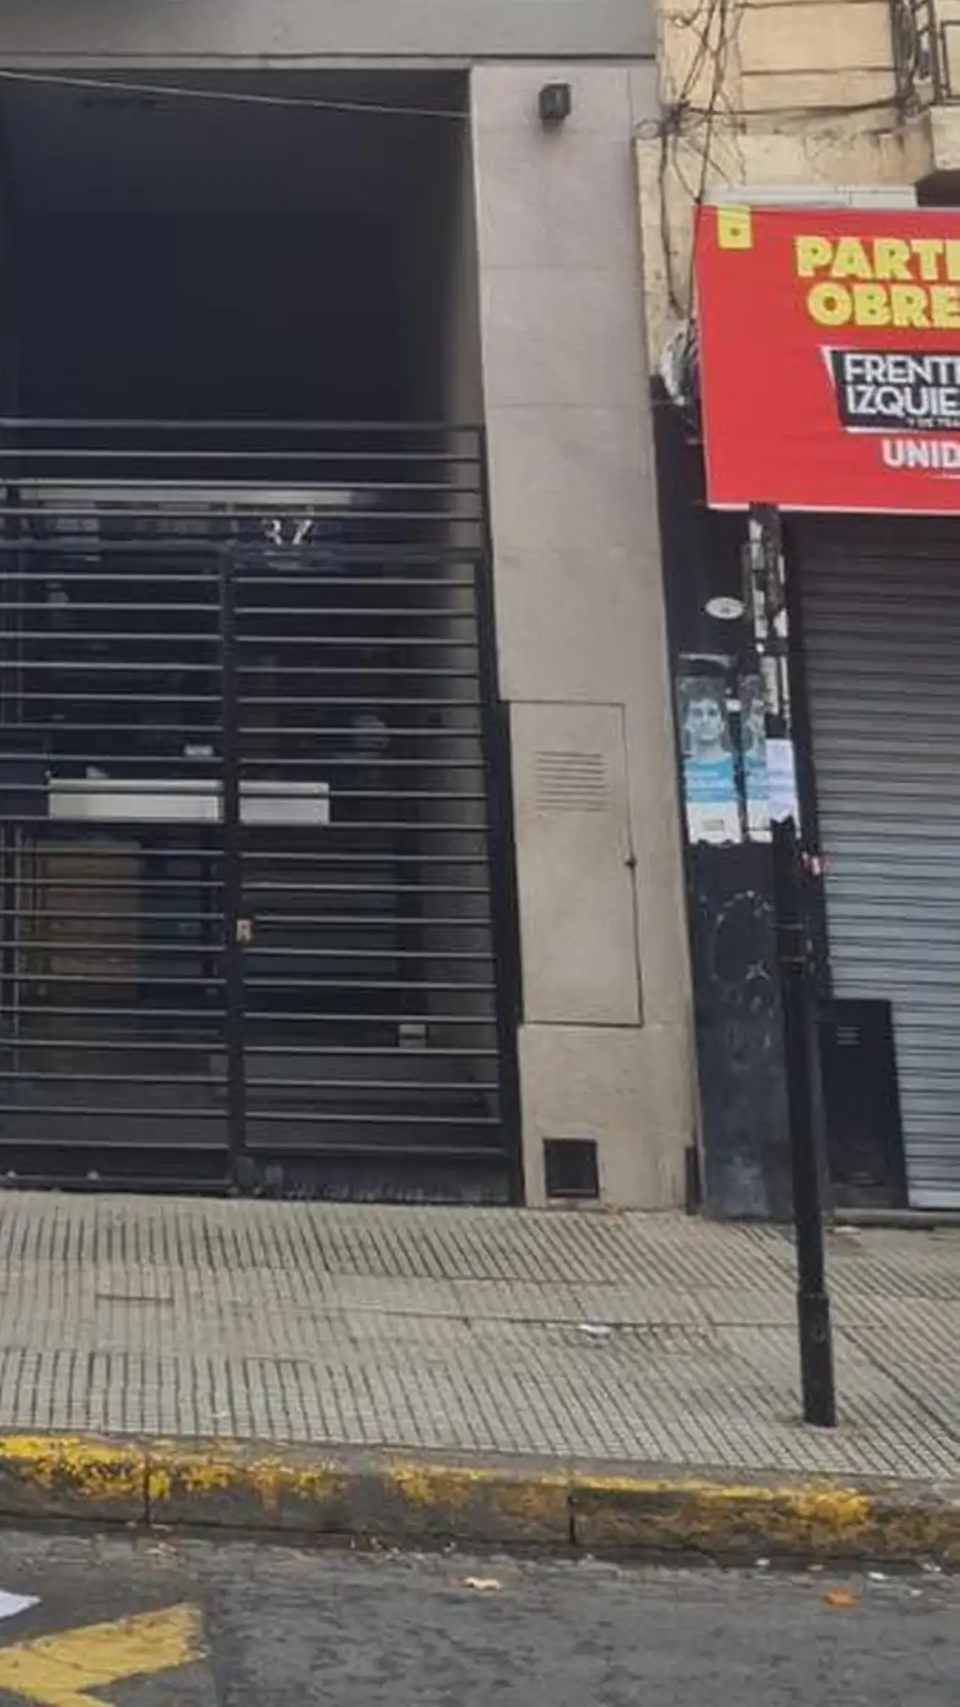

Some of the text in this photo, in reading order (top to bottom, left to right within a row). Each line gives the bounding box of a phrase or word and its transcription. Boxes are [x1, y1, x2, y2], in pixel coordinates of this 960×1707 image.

[807, 282, 960, 328] OBRE
[844, 354, 960, 384] FRENT
[846, 385, 960, 416] IZQUIE
